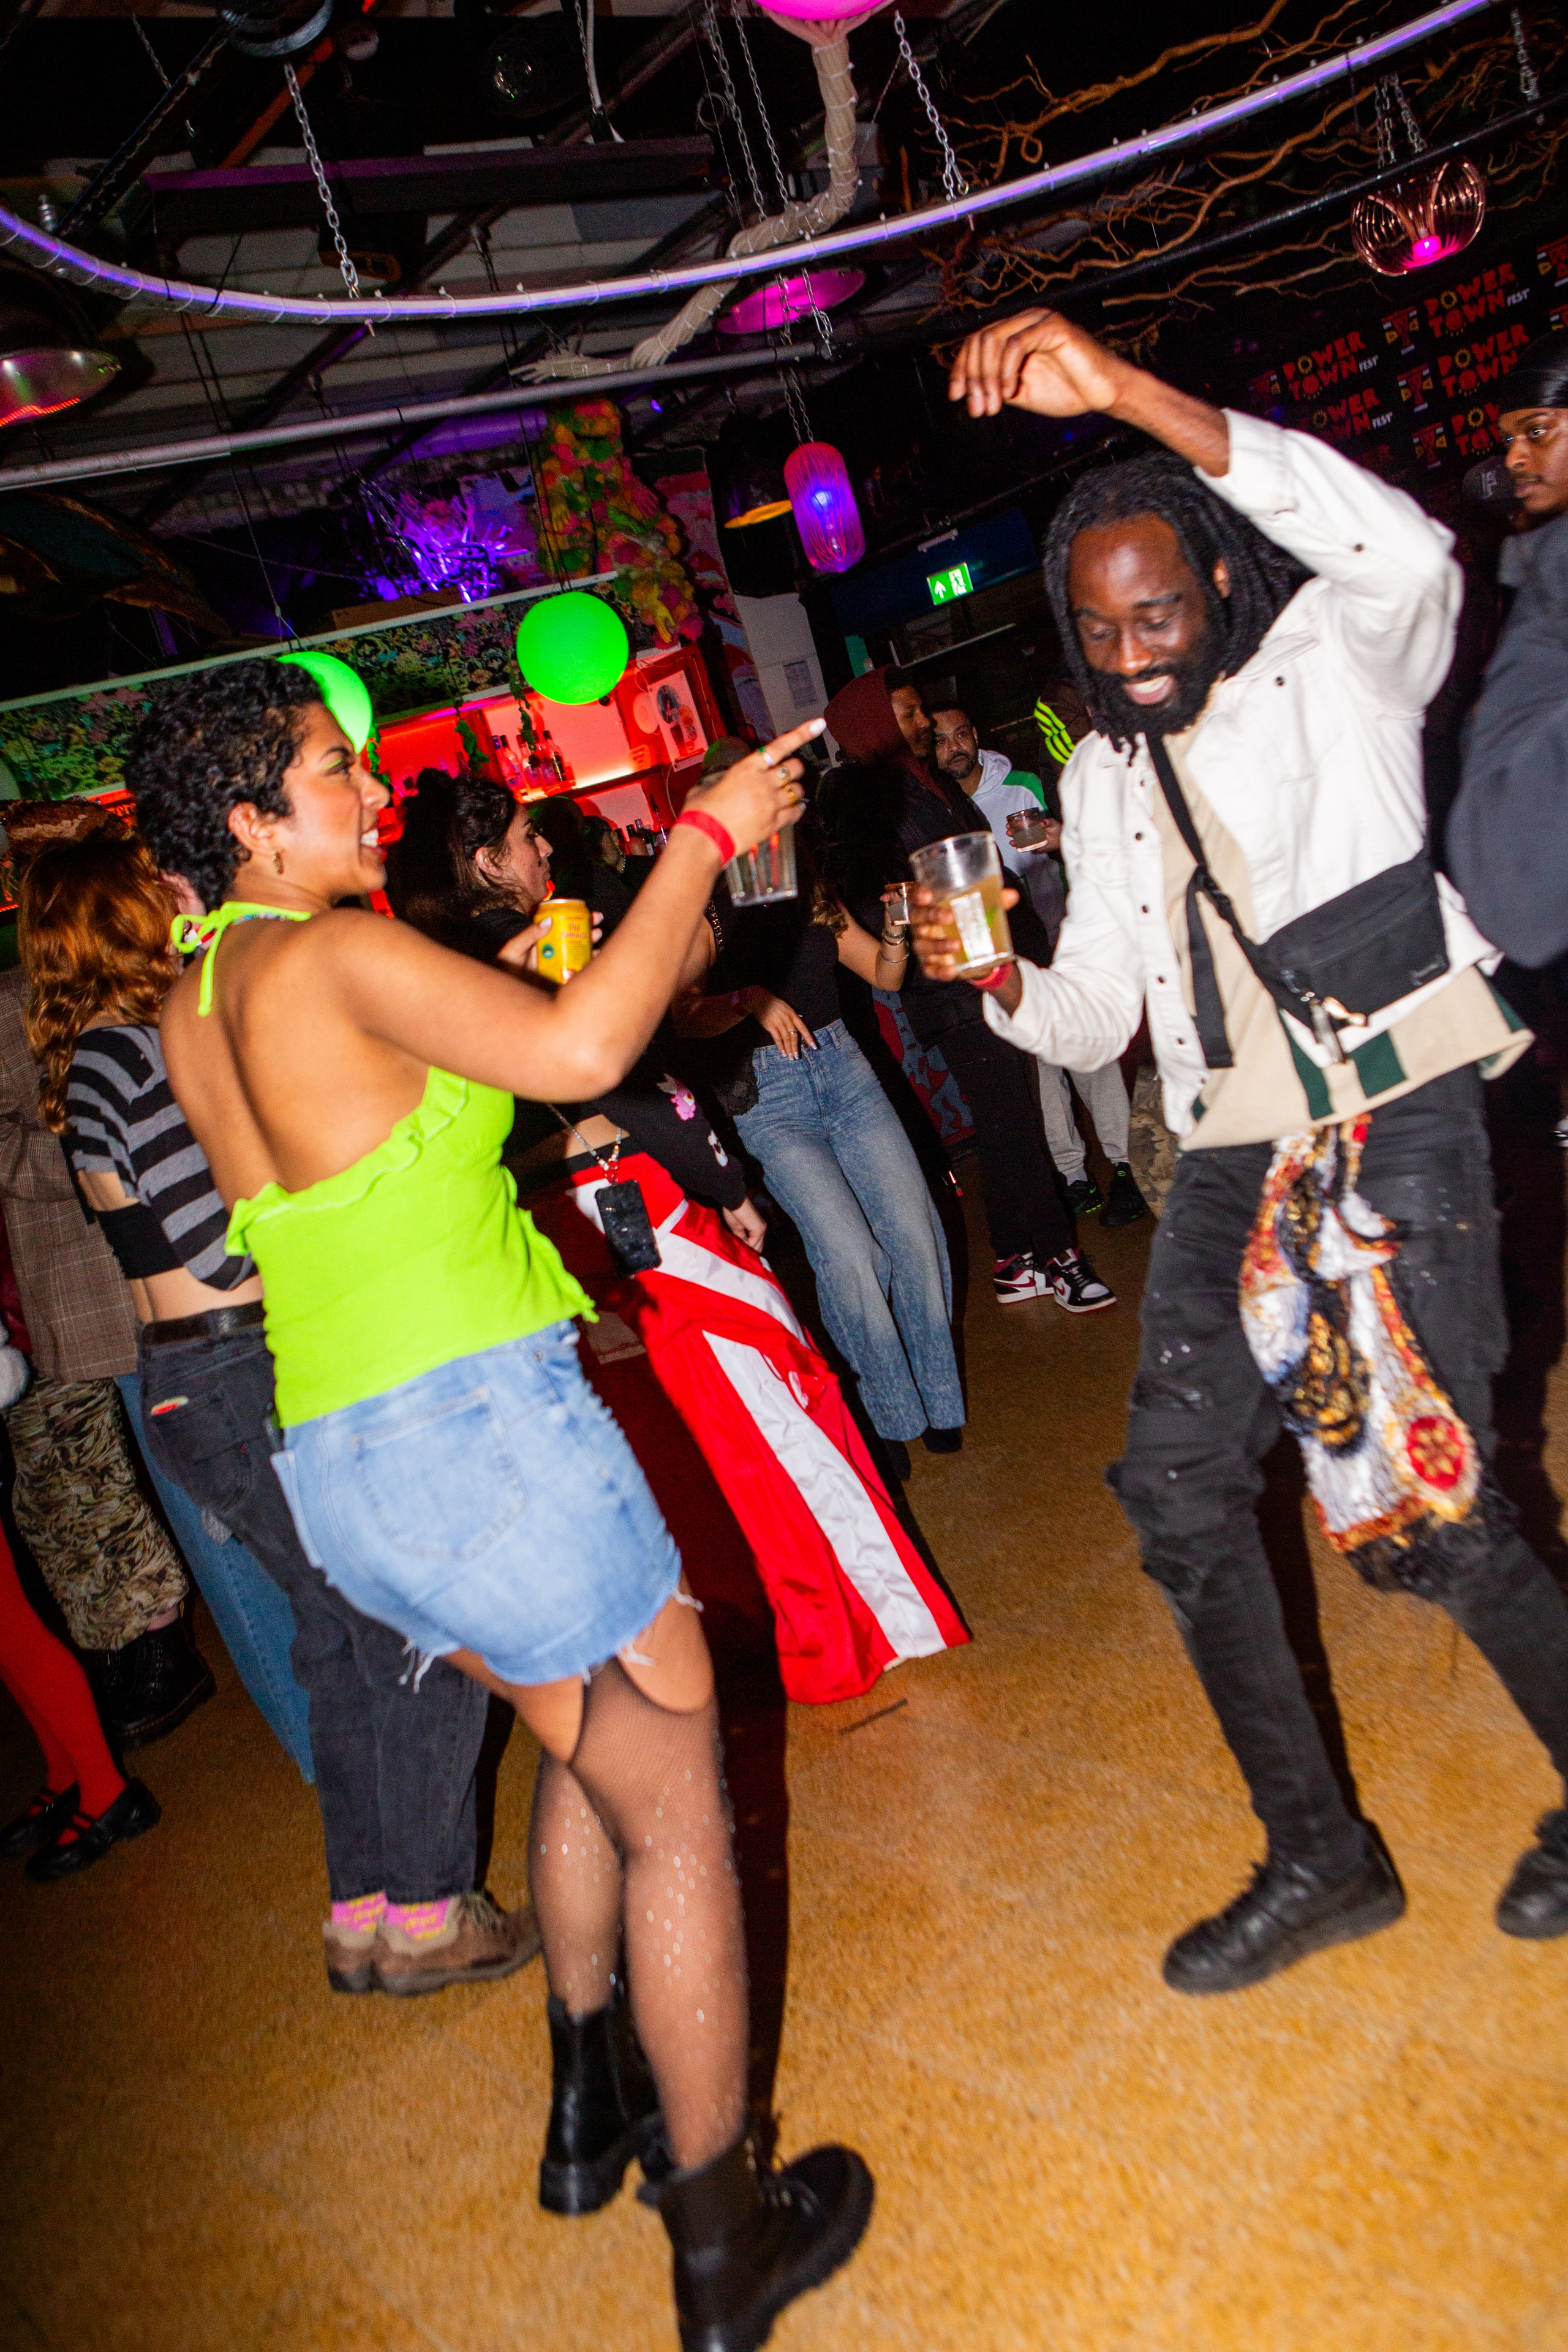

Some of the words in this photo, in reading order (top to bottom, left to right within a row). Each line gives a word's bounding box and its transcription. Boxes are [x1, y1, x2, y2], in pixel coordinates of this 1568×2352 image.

[1424, 263, 1517, 319] POWER
[1428, 288, 1506, 339] TOWN
[1282, 331, 1366, 382] POWER
[1437, 323, 1530, 377] POWER
[1288, 355, 1359, 401] TOWN
